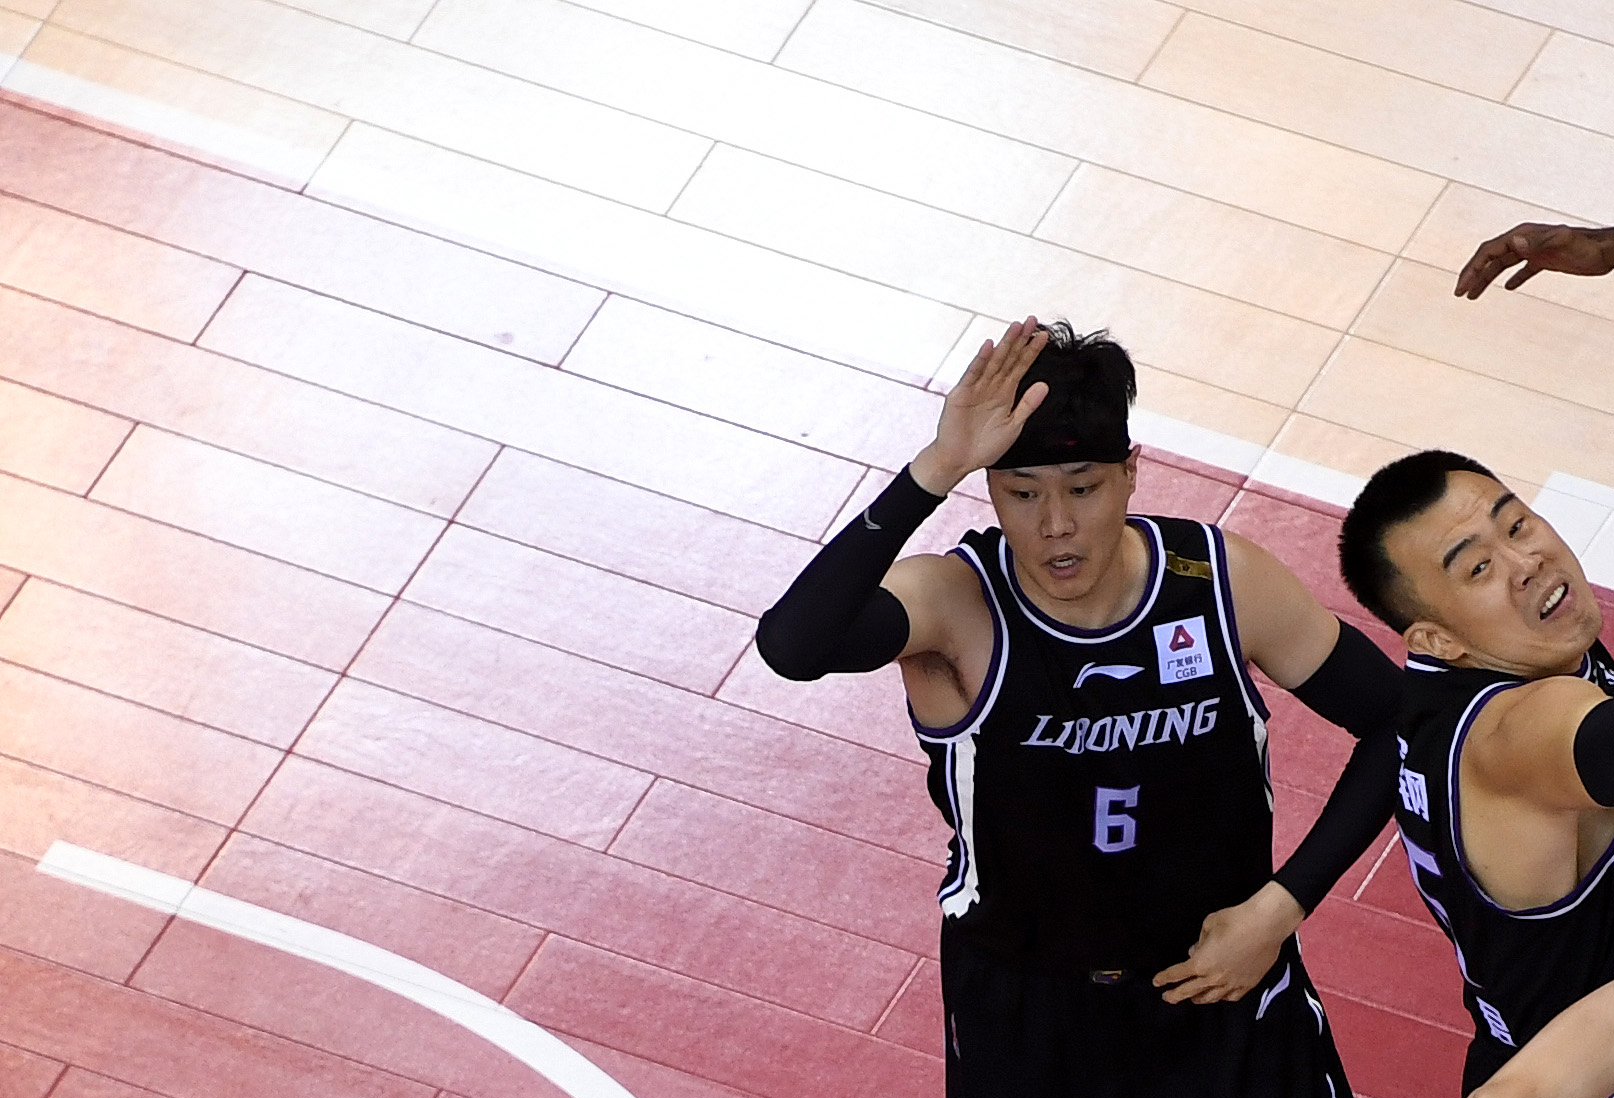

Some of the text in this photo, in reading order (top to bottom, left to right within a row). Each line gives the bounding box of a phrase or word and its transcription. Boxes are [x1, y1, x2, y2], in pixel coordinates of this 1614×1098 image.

[1167, 653, 1203, 670] 广发银行
[1175, 667, 1198, 679] CGB
[1092, 784, 1141, 853] 6
